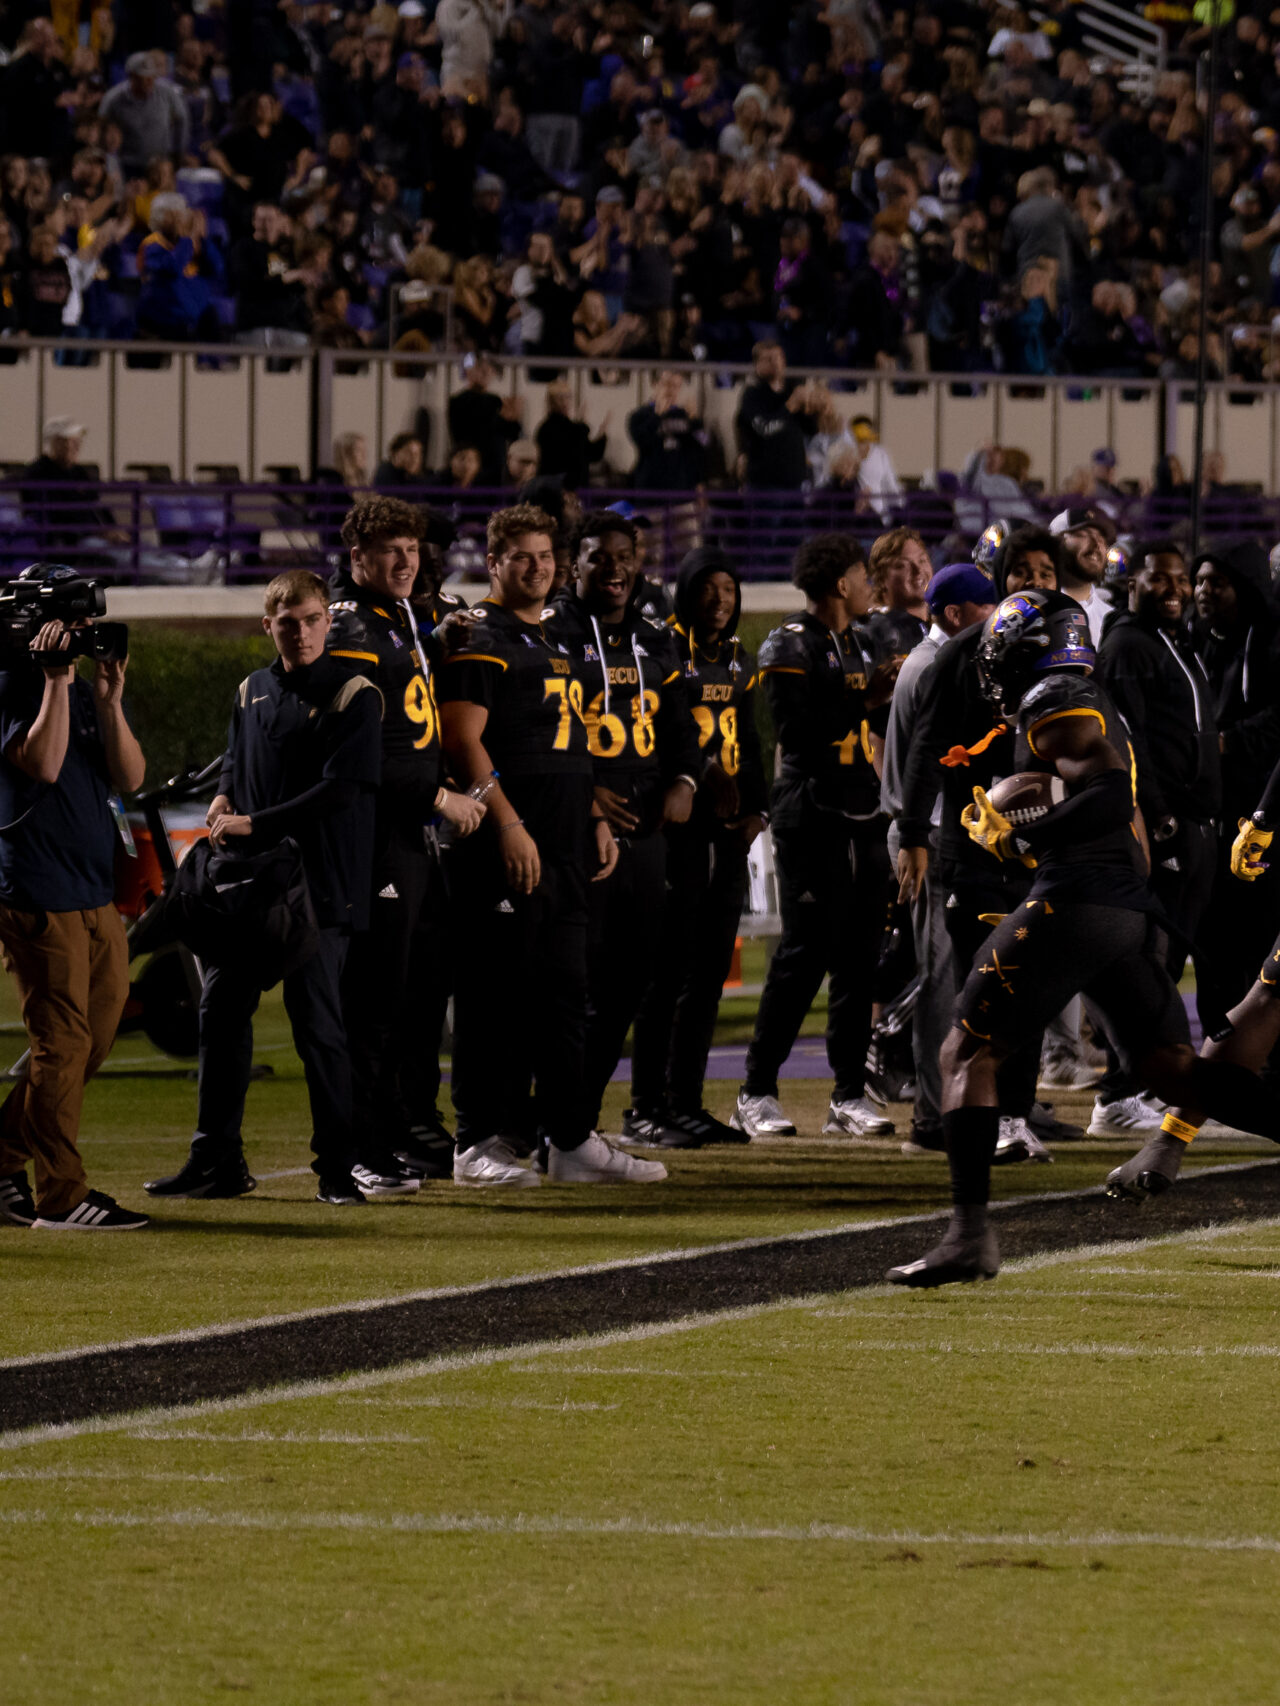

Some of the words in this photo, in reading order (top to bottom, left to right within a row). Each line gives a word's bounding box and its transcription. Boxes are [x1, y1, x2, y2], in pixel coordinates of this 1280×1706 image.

[606, 667, 638, 684] ECU
[701, 684, 734, 702] ECU
[582, 689, 660, 758] 68
